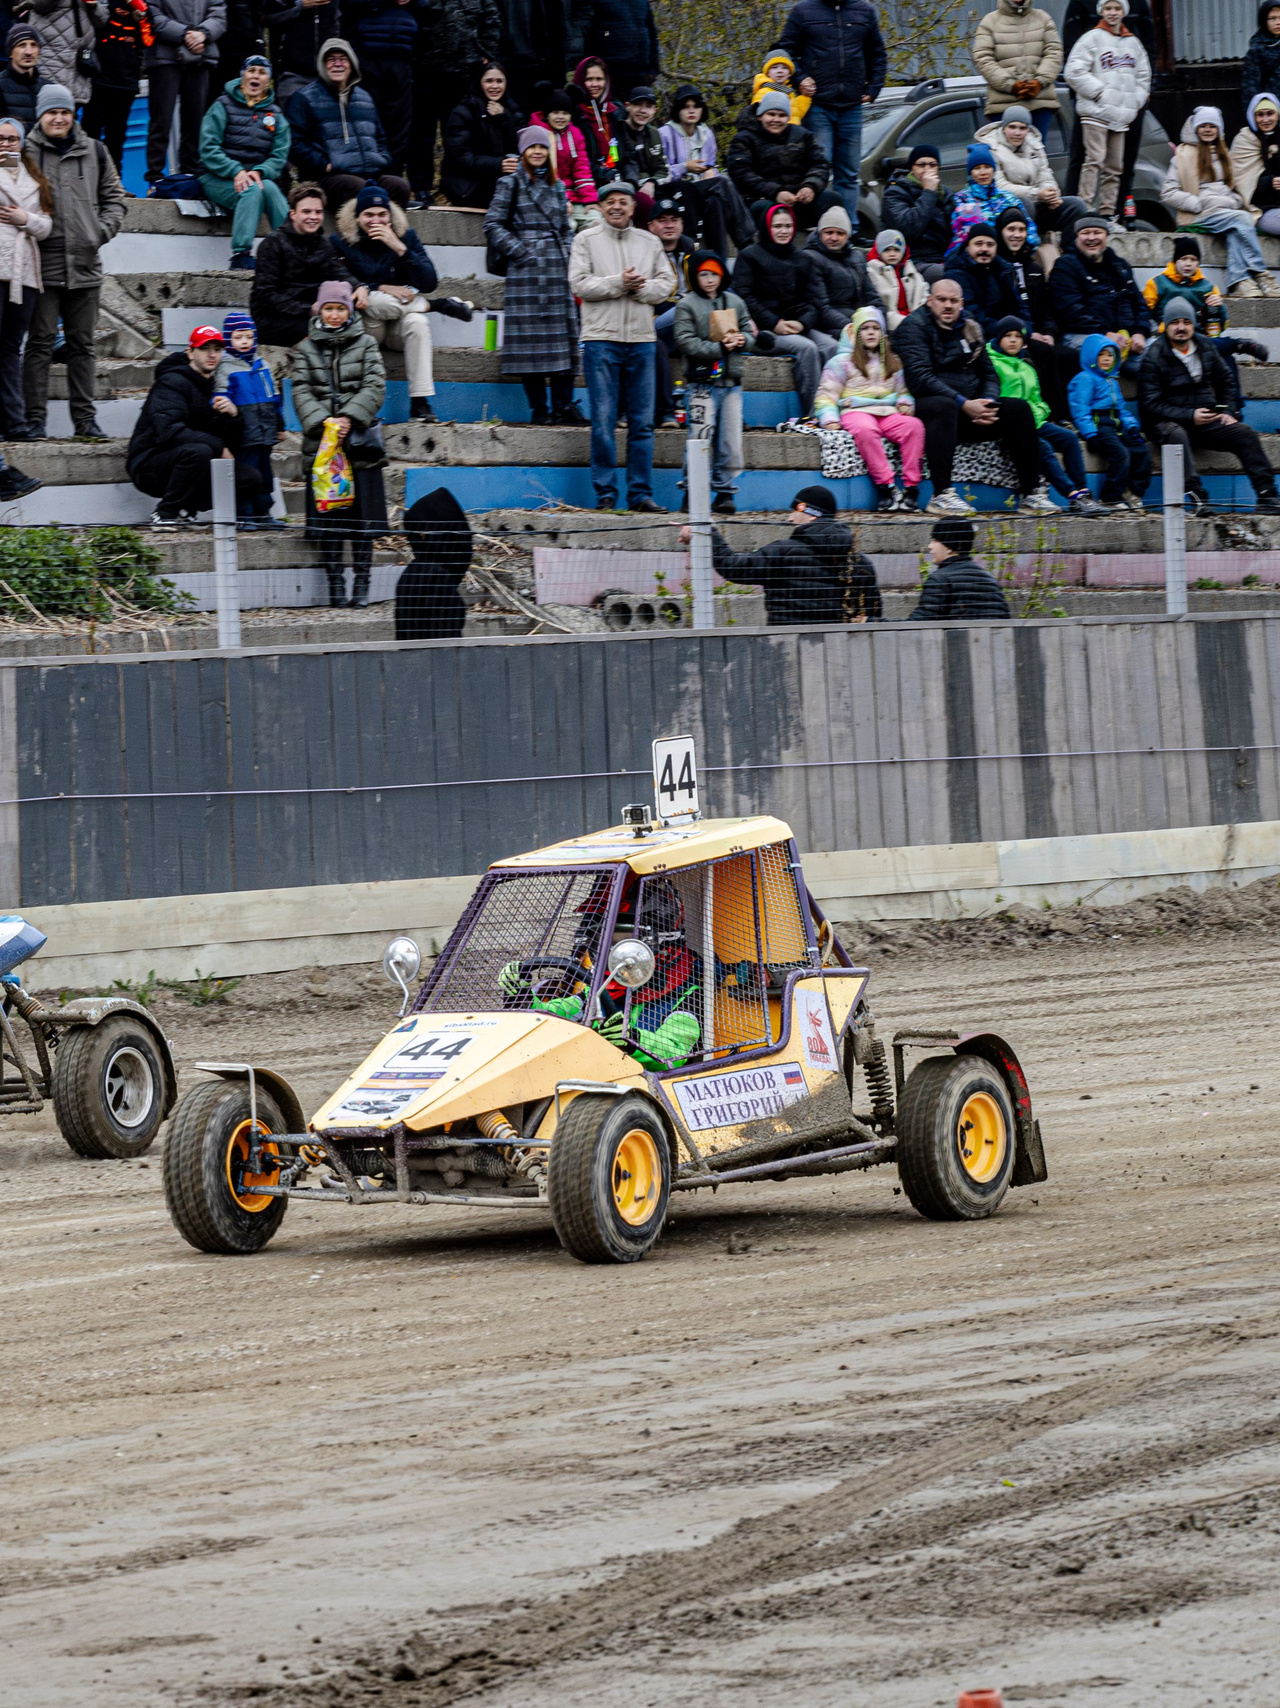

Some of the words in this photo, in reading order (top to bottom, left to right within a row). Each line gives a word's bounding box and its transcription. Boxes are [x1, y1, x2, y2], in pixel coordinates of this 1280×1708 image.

[659, 751, 696, 802] 44
[397, 1037, 473, 1061] 44
[806, 1036, 819, 1052] 80
[684, 1070, 777, 1103] МАТЮКОВ
[691, 1090, 786, 1128] ГРИГОРИЙ
